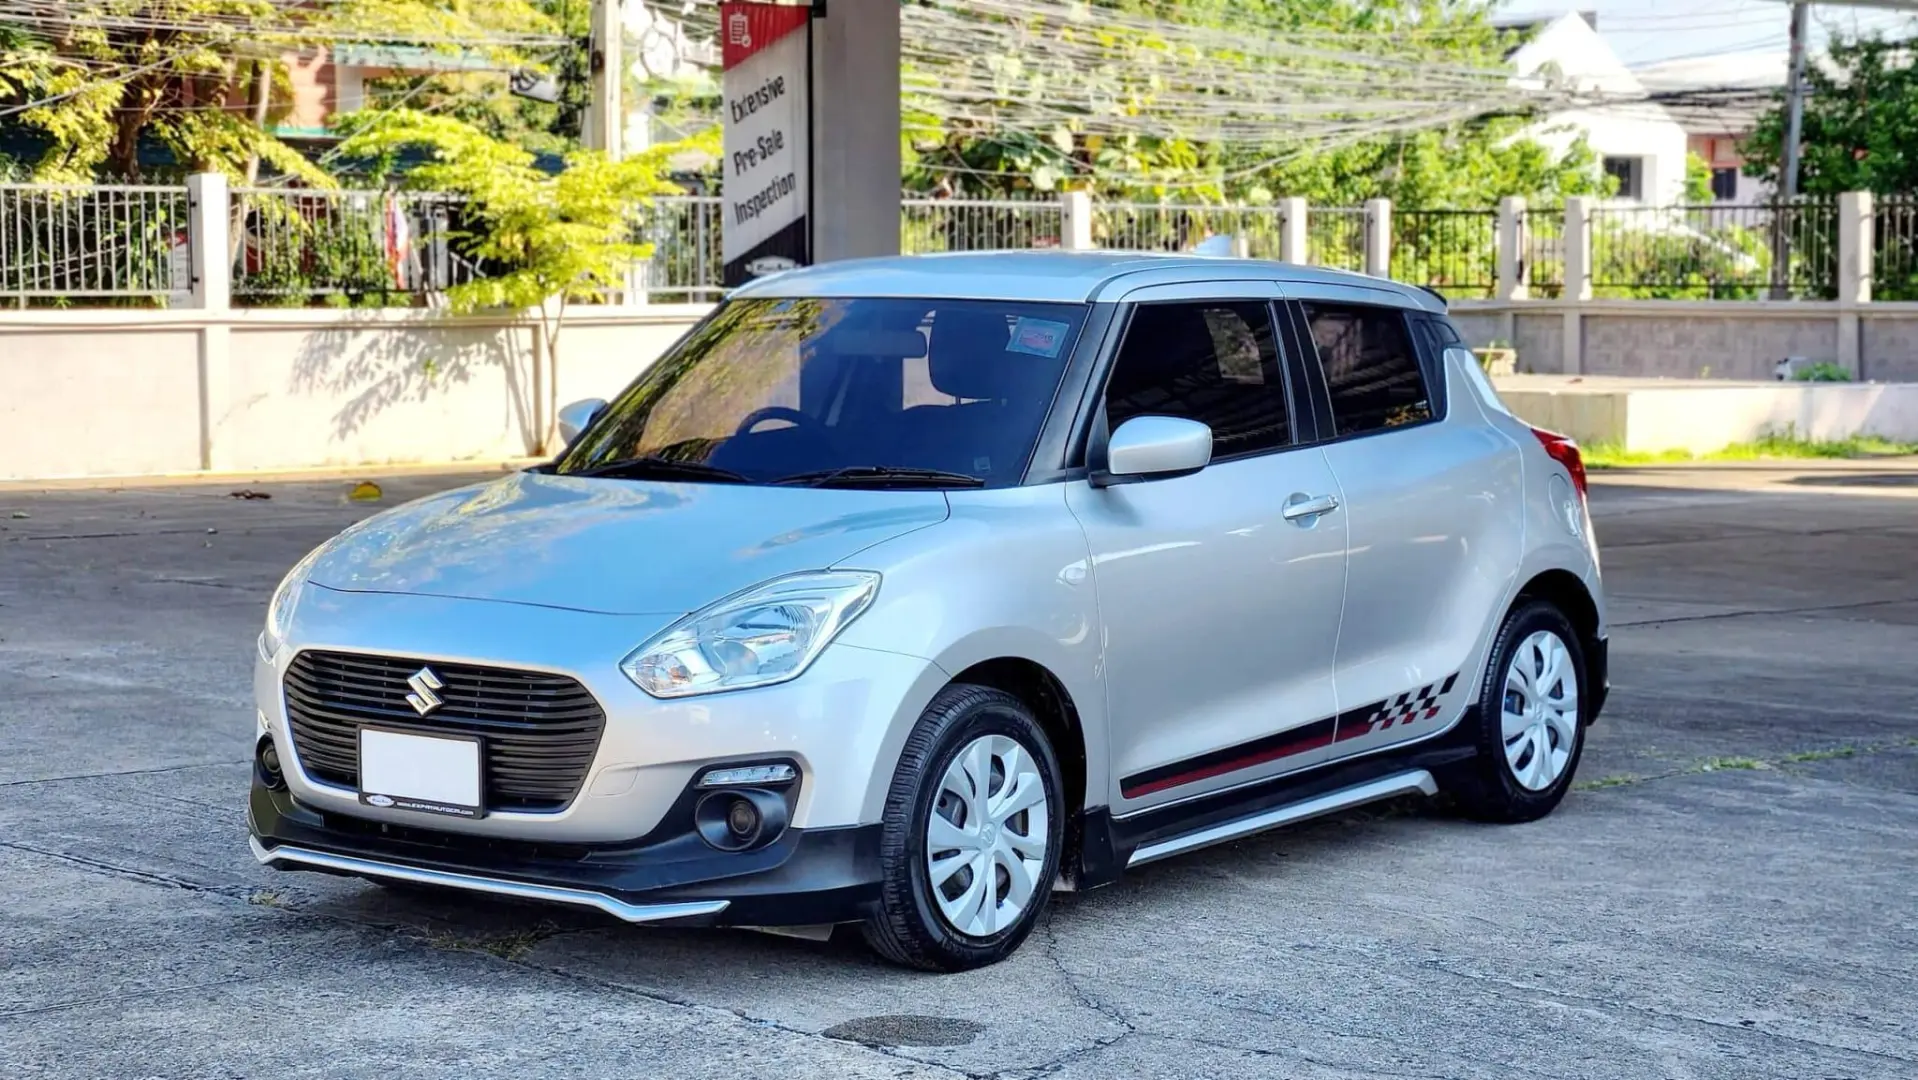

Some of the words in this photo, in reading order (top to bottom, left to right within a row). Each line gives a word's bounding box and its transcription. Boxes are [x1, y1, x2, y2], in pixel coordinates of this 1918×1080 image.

[730, 74, 785, 124] Extensive
[733, 128, 784, 177] Pre-Sale
[734, 170, 796, 225] Inspection
